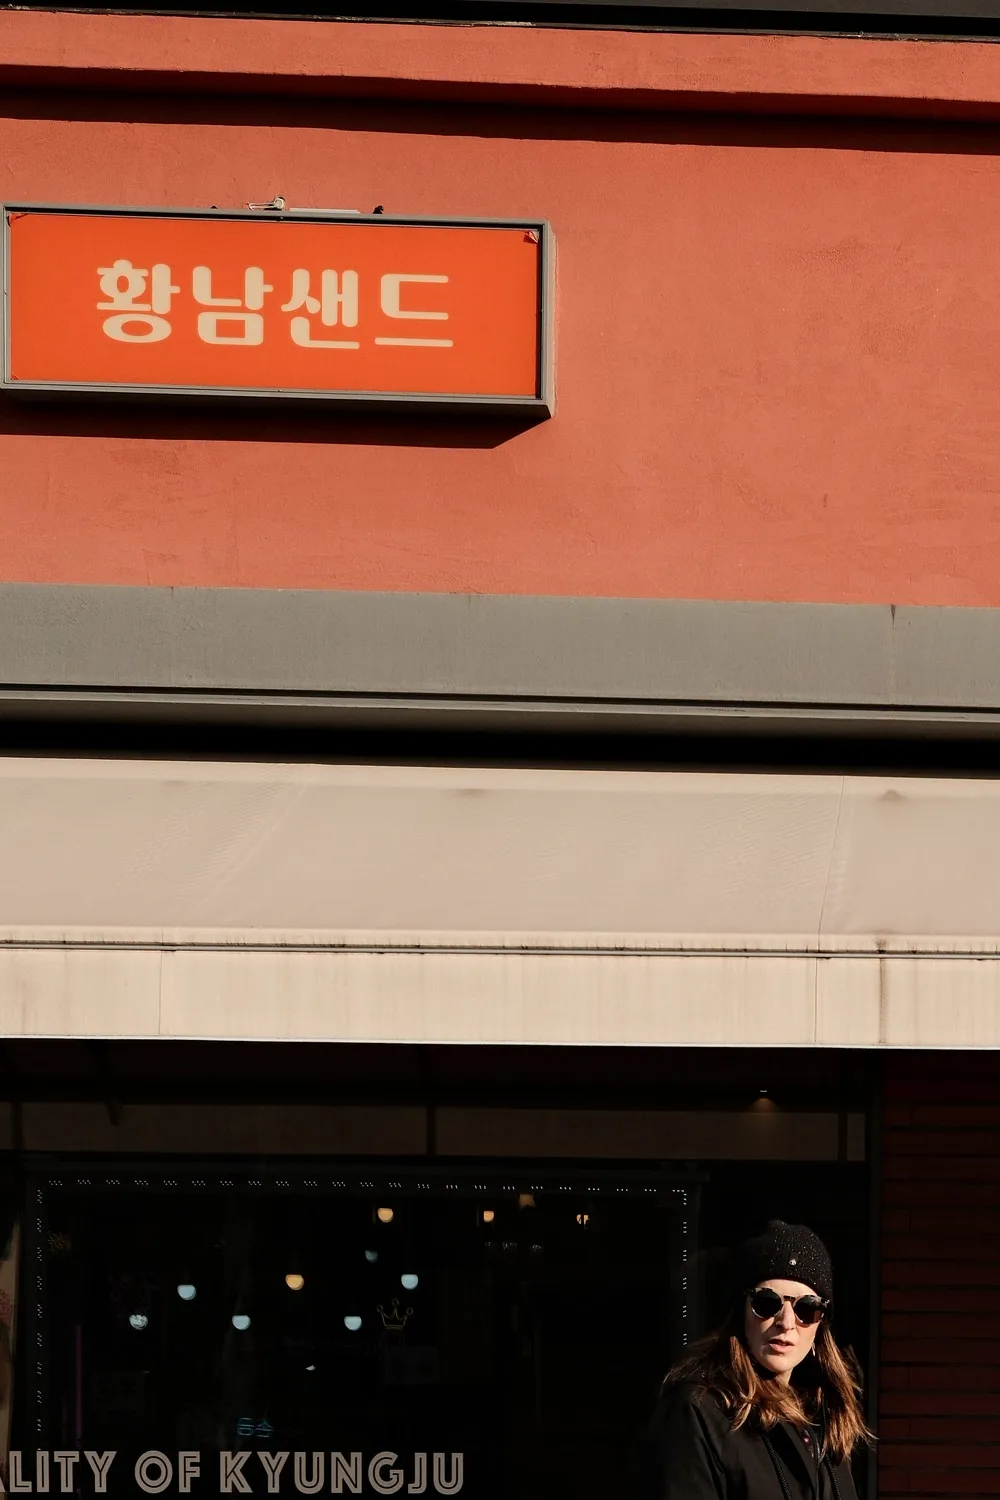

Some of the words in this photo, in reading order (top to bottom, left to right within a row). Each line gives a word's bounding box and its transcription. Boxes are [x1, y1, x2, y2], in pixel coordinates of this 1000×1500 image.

[97, 260, 453, 349] 황남샌드
[0, 1450, 117, 1493] LITY
[134, 1451, 201, 1494] OF
[219, 1452, 464, 1495] KYUNGJU
